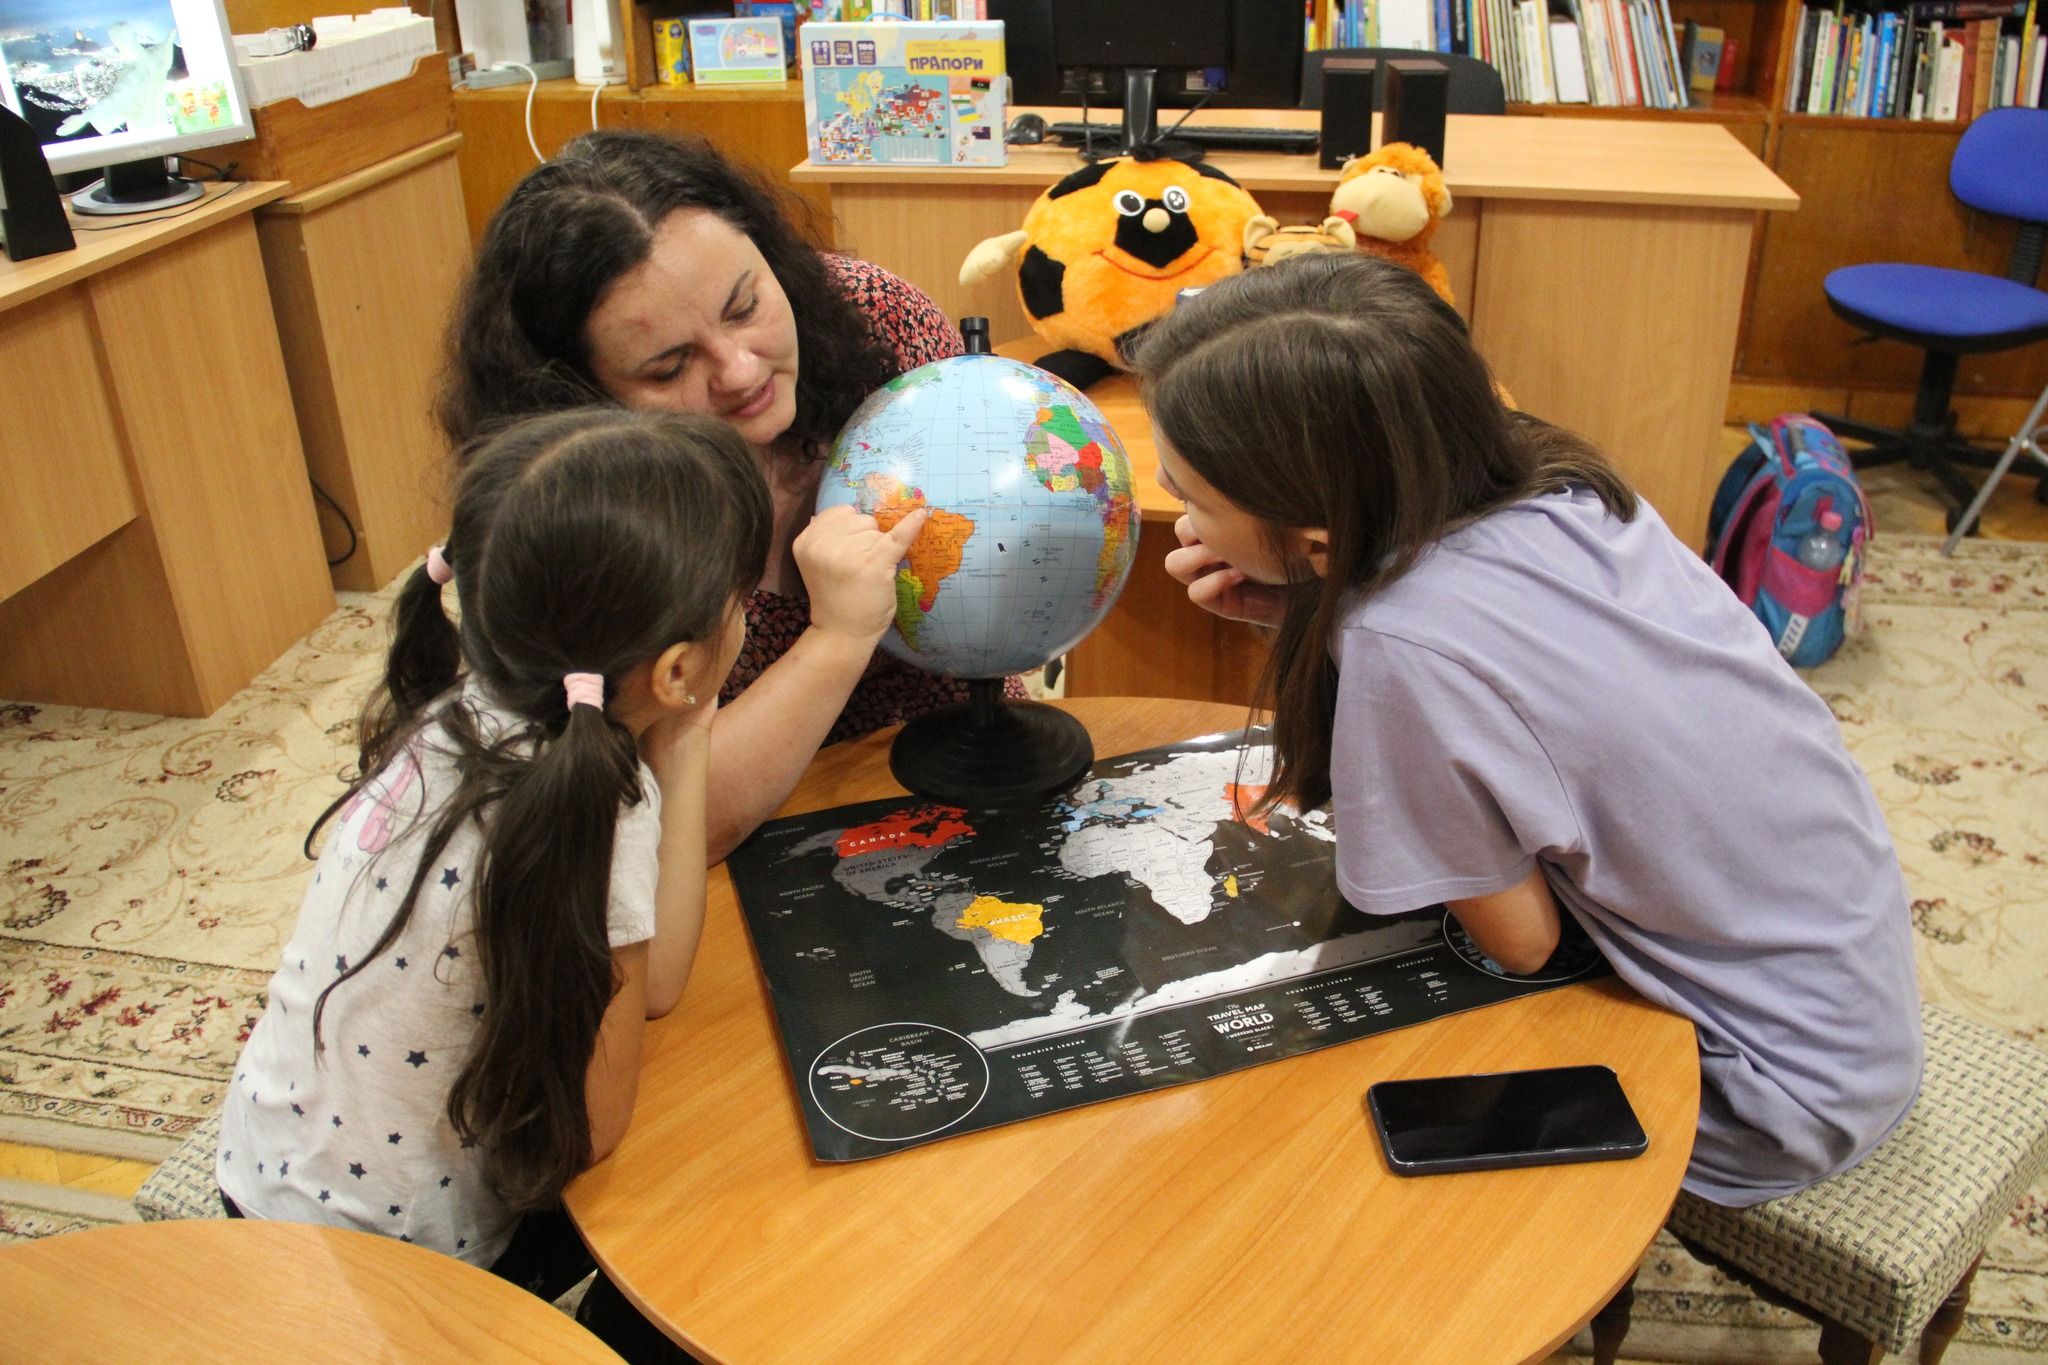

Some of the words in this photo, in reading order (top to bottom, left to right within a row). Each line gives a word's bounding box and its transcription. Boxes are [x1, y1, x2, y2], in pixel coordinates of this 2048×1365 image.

[909, 56, 984, 71] ПРАПОРИ
[849, 831, 906, 847] CANADA
[843, 861, 876, 872] UNITED
[859, 862, 897, 874] AMERICA
[779, 887, 801, 897] NORTH
[802, 883, 825, 893] PACIFIC
[793, 892, 815, 900] OCEAN
[1074, 906, 1097, 916] SOUTH
[1093, 910, 1115, 919] OCEAN
[1161, 951, 1195, 962] SOUTHERN
[1196, 945, 1218, 955] OCEAN
[849, 969, 871, 978] SOUTH
[850, 974, 875, 983] PACIFIC
[852, 980, 876, 989] OCEAN
[1285, 983, 1324, 995] COUNTRIES
[1326, 976, 1353, 986] LEGEND
[1206, 1009, 1244, 1022] TRAVEL
[1244, 1003, 1265, 1013] MAP
[1213, 1013, 1274, 1034] WORLD
[888, 1030, 930, 1043] CARIBBEAN
[1229, 1029, 1254, 1038] WEEKEND
[1254, 1025, 1271, 1033] BLACK
[901, 1038, 923, 1048] BASIN
[1012, 1046, 1054, 1059] COUNTRIES
[1057, 1039, 1086, 1049] LEGEND
